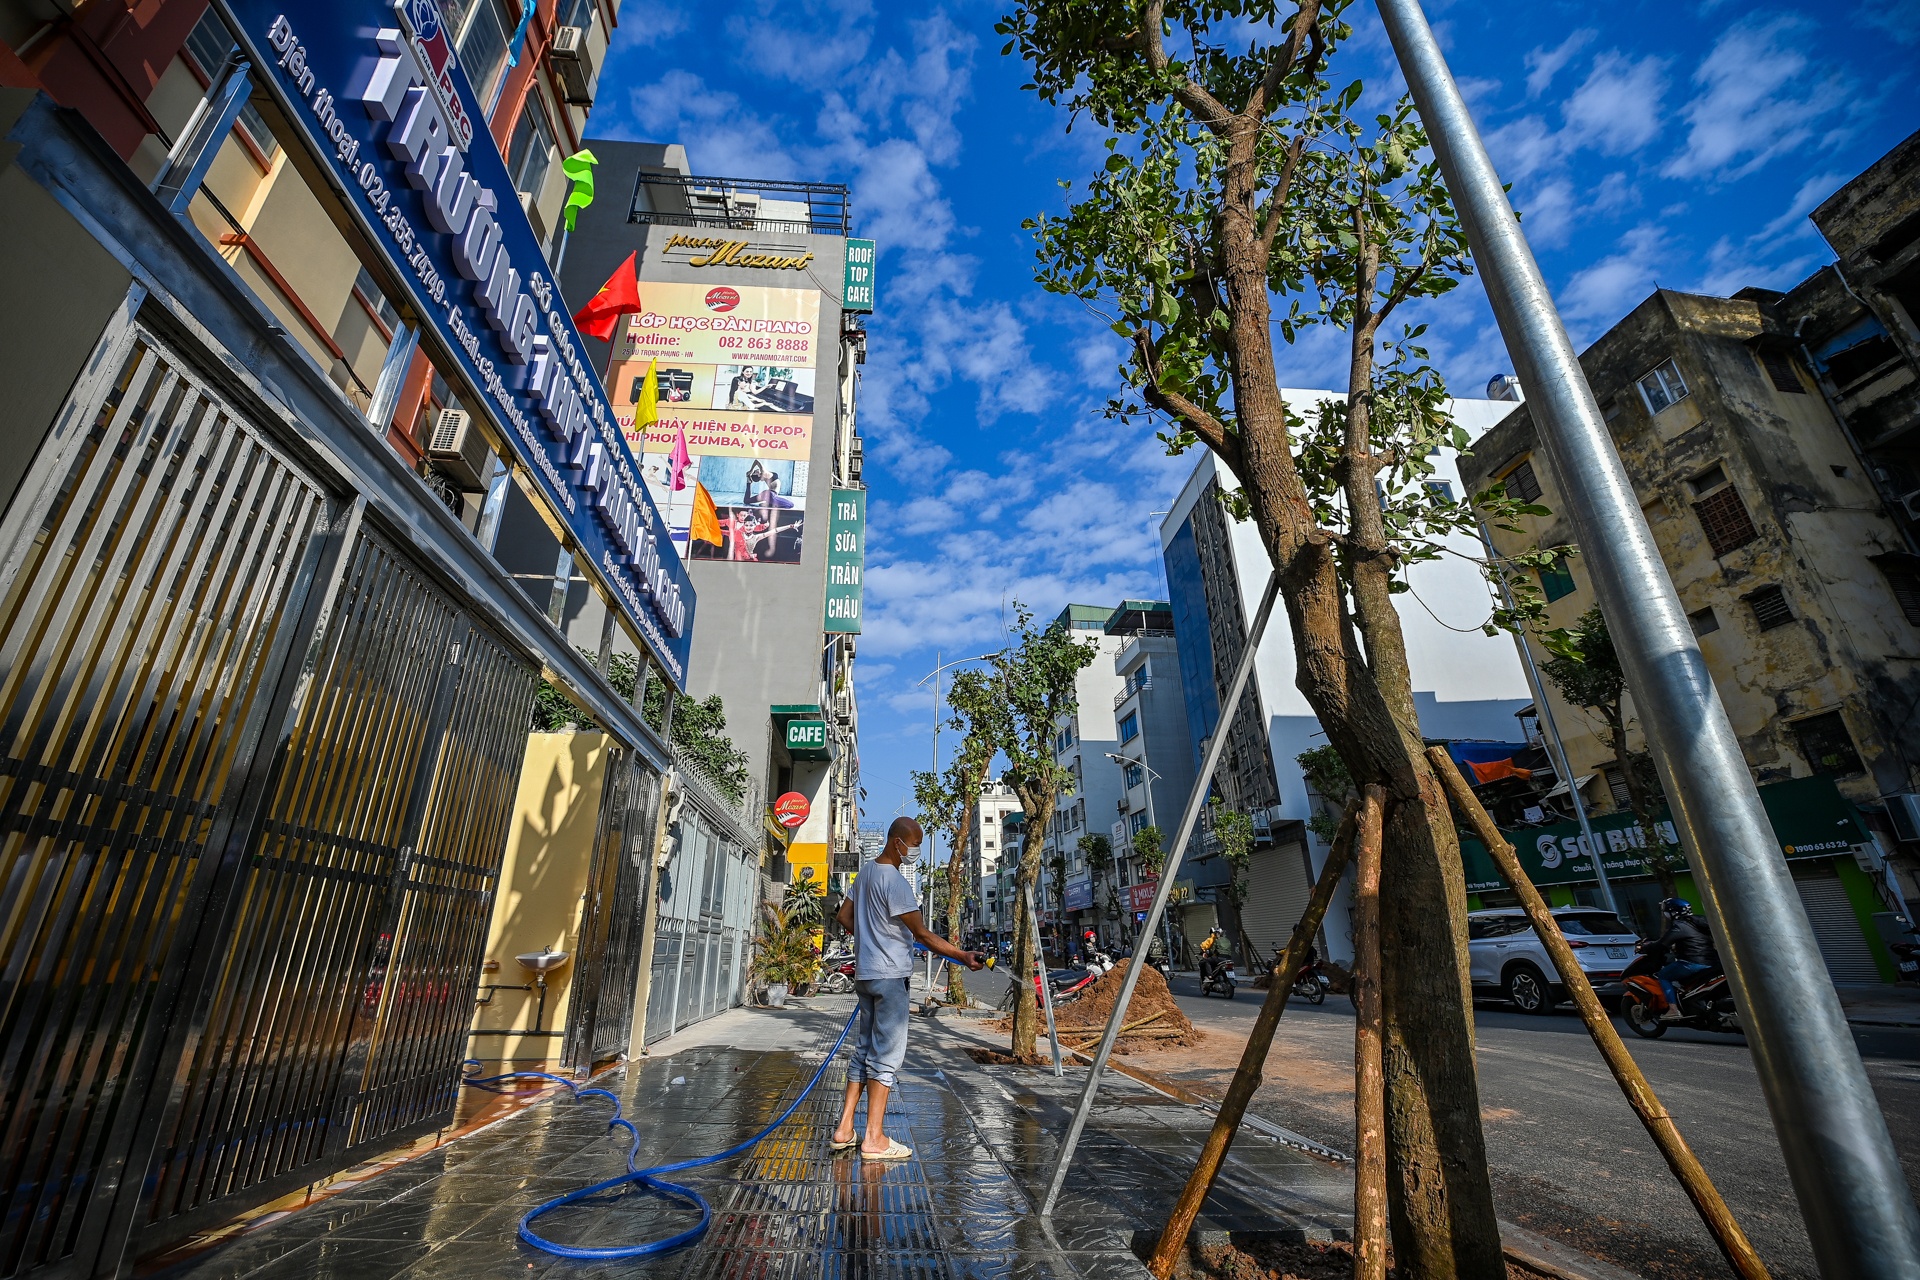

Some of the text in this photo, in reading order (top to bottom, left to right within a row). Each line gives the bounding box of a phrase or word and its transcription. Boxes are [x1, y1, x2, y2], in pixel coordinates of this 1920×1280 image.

[265, 14, 315, 98] Điện
[440, 71, 471, 141] PBC
[662, 233, 815, 270] piano Mozart
[848, 246, 872, 264] ROOF
[851, 266, 869, 283] TOP
[706, 291, 738, 300] Mozart
[847, 286, 870, 303] CAFE
[629, 312, 811, 334] LỚP HỌC ĐÀN PIANO
[362, 28, 538, 366] TRƯỜNG
[528, 334, 597, 471] THPT
[585, 442, 639, 556] PHAN
[630, 526, 661, 594] BỘI
[654, 568, 686, 638] CHÂU
[626, 333, 809, 351] Hotline: 082 863 8888
[548, 311, 576, 368] GIÁO
[572, 358, 595, 406] DỤC
[640, 349, 660, 357] TRỌNG
[660, 350, 680, 358] PHỤNG
[732, 352, 808, 362] WWW.PIANOMOZART.COM
[692, 419, 726, 433] HIỆN
[730, 423, 759, 435] ĐẠI,
[763, 424, 806, 438] KPOP,
[688, 435, 745, 449] ZUMBA,
[749, 438, 789, 449] YOGA
[837, 501, 858, 521] TRÀ
[835, 529, 857, 552] SỮA
[830, 562, 859, 585] TRÂN
[828, 594, 858, 619] CHÂU
[789, 726, 823, 743] CAFE
[775, 800, 808, 811] Mozart
[1795, 840, 1848, 853] 1900 63 63 26
